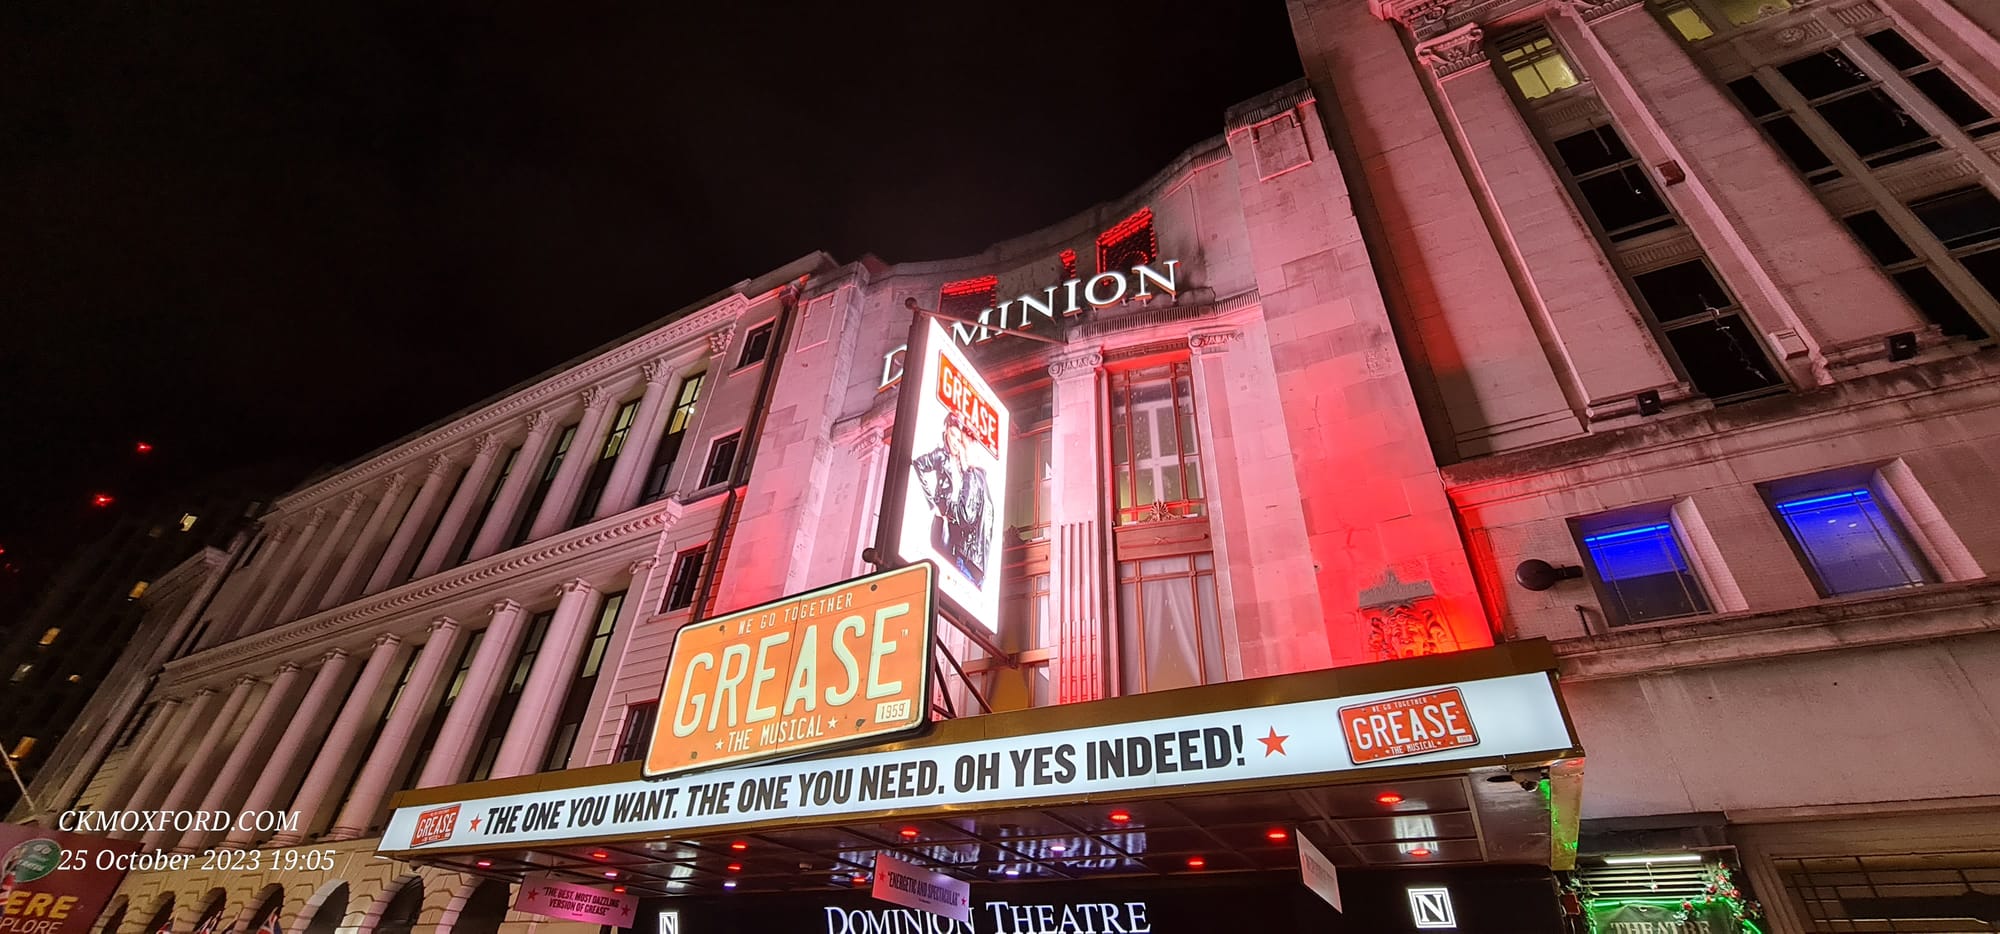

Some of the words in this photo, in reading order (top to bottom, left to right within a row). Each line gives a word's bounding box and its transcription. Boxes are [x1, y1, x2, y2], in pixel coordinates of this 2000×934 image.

[878, 260, 1179, 391] DMINION
[943, 366, 997, 446] GREASE
[738, 616, 752, 635] WE
[760, 612, 776, 629] GO
[784, 592, 853, 623] TOGETHER
[673, 602, 910, 738] GREASE
[880, 702, 905, 721] 1959
[1394, 697, 1428, 709] TOGETHER
[727, 729, 752, 752] THE
[760, 715, 824, 743] MUSICAL
[1352, 701, 1466, 750] GREASE
[1389, 746, 1404, 756] THE
[1406, 740, 1438, 753] MUSICAL
[484, 805, 522, 835] THE
[521, 801, 564, 831] ONE
[567, 796, 609, 828] YOU
[612, 788, 680, 823] WANT.
[686, 782, 735, 816] THE
[737, 776, 792, 813] ONE
[799, 768, 853, 807] YOU
[858, 760, 944, 801] NEED.
[954, 751, 1000, 793] OH
[1009, 743, 1076, 787] YES
[1086, 725, 1245, 780] INDEED!
[416, 812, 456, 839] GREASE
[549, 897, 576, 911] VERSION
[576, 902, 585, 912] OF
[574, 892, 592, 904] MOST
[1415, 894, 1446, 922] N
[985, 901, 1151, 934] THEATRE
